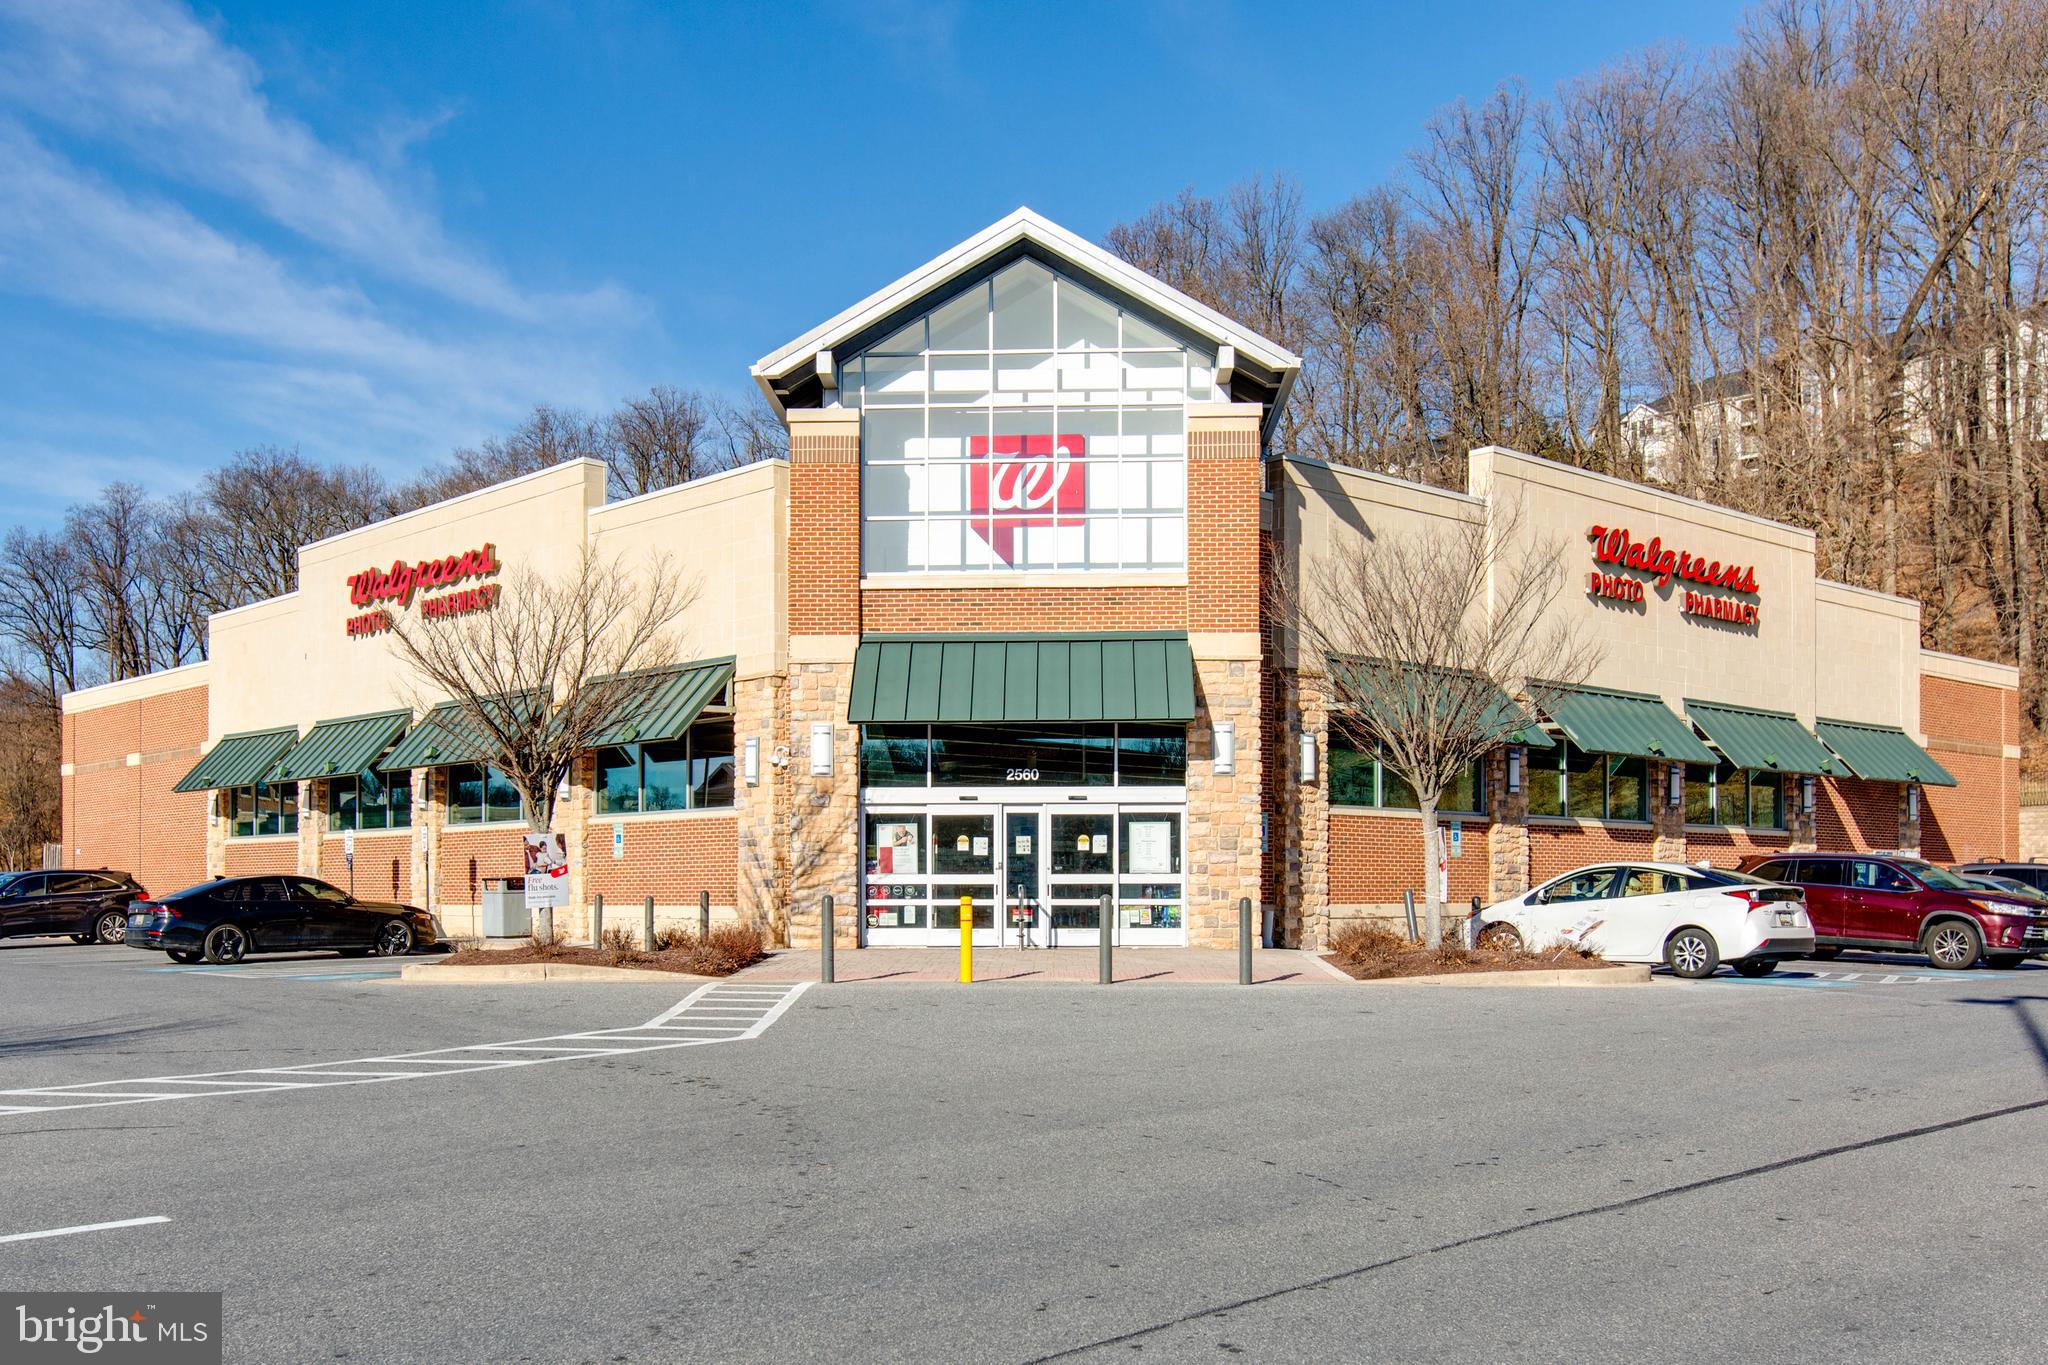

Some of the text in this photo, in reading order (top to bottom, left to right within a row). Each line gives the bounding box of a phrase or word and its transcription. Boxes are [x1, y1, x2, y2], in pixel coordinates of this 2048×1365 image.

[347, 543, 495, 606] Walgreens
[1587, 525, 1759, 594] Walgreens
[346, 583, 495, 637] PHOTO PHARMACY
[1590, 572, 1759, 625] PHOTO PHARMACY
[1006, 768, 1040, 781] 2560
[528, 883, 538, 891] flu
